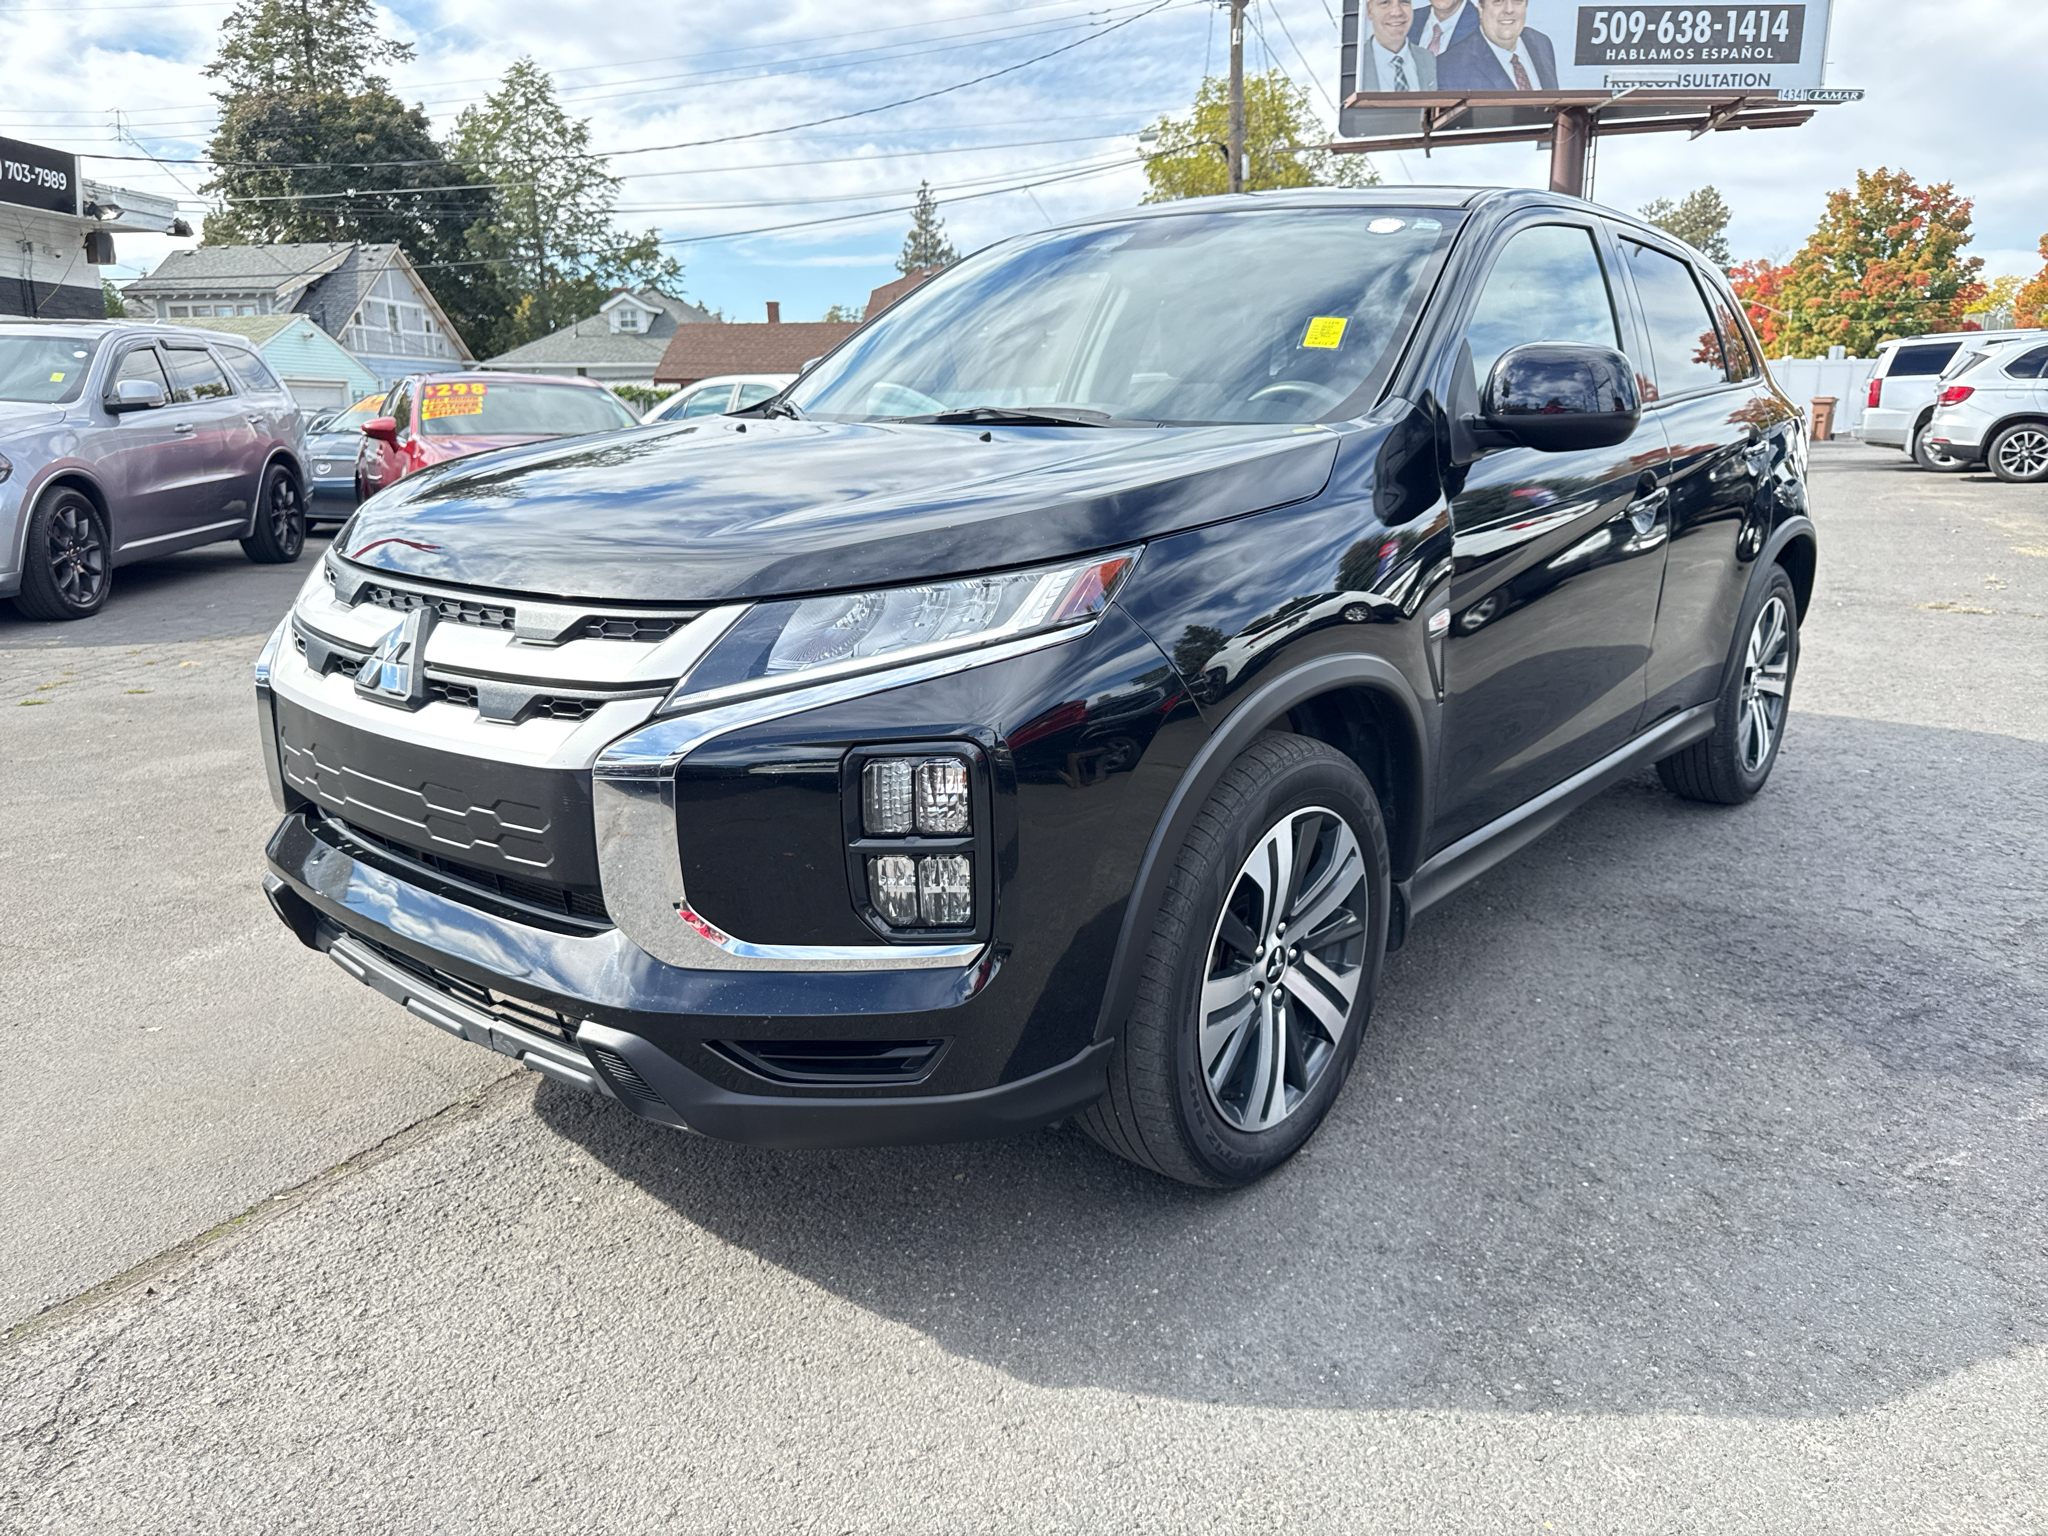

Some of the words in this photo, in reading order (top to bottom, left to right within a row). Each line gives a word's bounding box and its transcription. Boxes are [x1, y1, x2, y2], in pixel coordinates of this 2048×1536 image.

[1591, 10, 1789, 44] 509-638-1414
[1606, 48, 1695, 60] HABLAMOS
[1702, 45, 1774, 59] ESPAÑOL
[1813, 91, 1859, 100] LAMAR
[4, 160, 67, 190] 703-7989
[425, 383, 485, 397] $298
